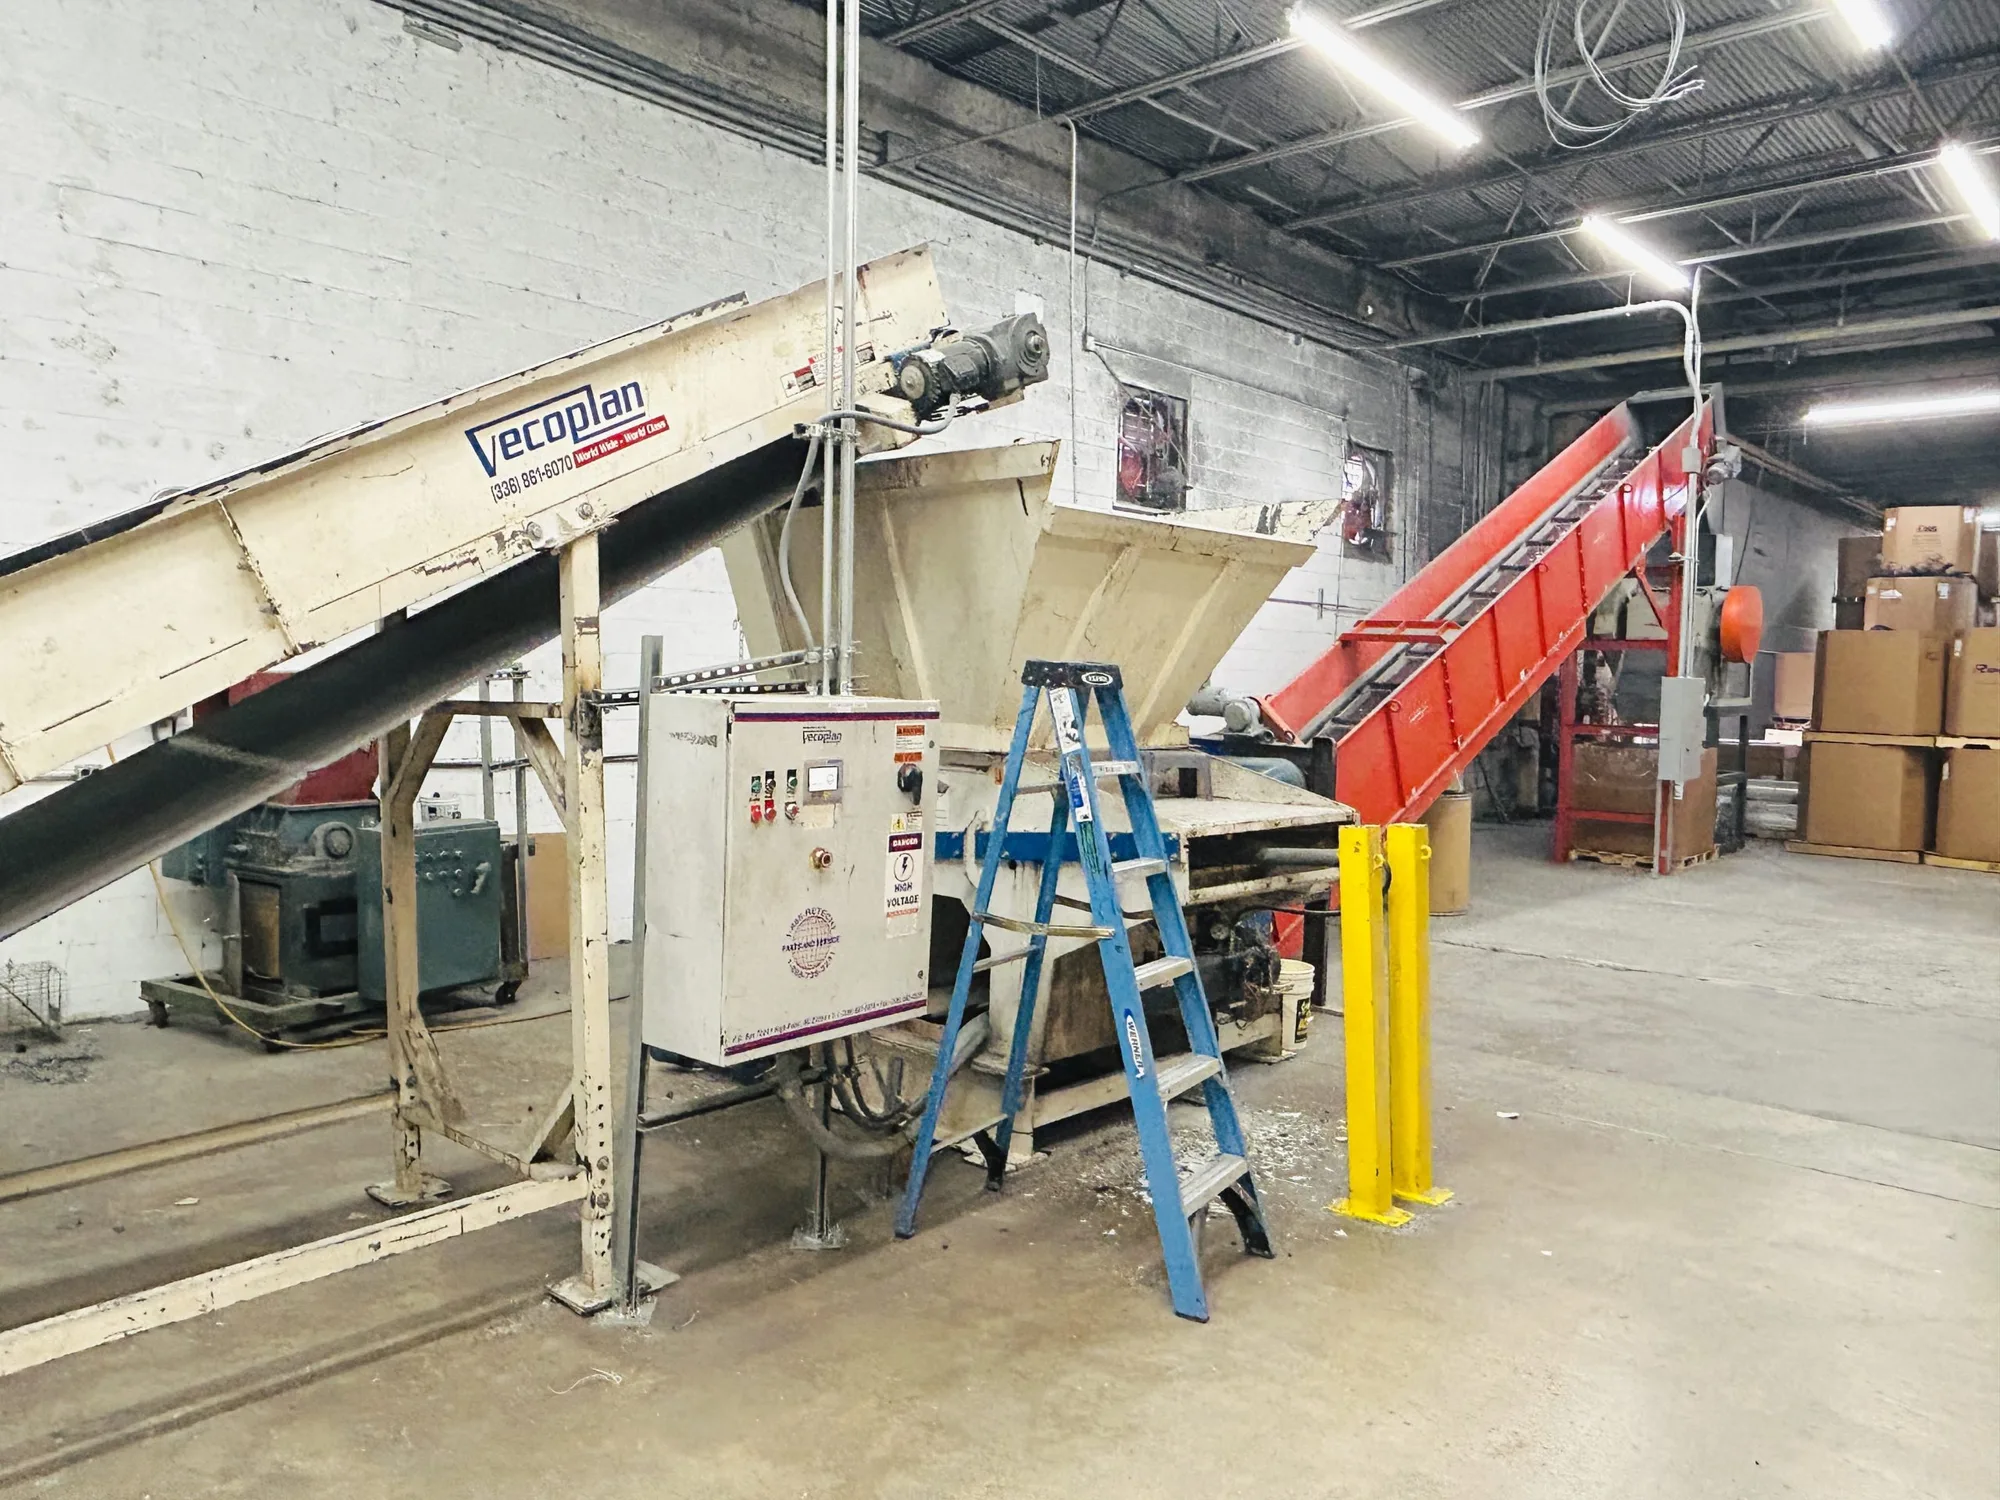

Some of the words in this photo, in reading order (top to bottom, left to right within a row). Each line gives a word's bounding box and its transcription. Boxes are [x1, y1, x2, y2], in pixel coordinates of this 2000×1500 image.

[465, 381, 646, 478] Vecoplan
[575, 446, 599, 463] World
[623, 426, 646, 442] World
[491, 476, 522, 504] (336)
[521, 454, 573, 488] 861-6070
[892, 837, 918, 847] DANGER
[886, 894, 919, 908] VOLTAGE
